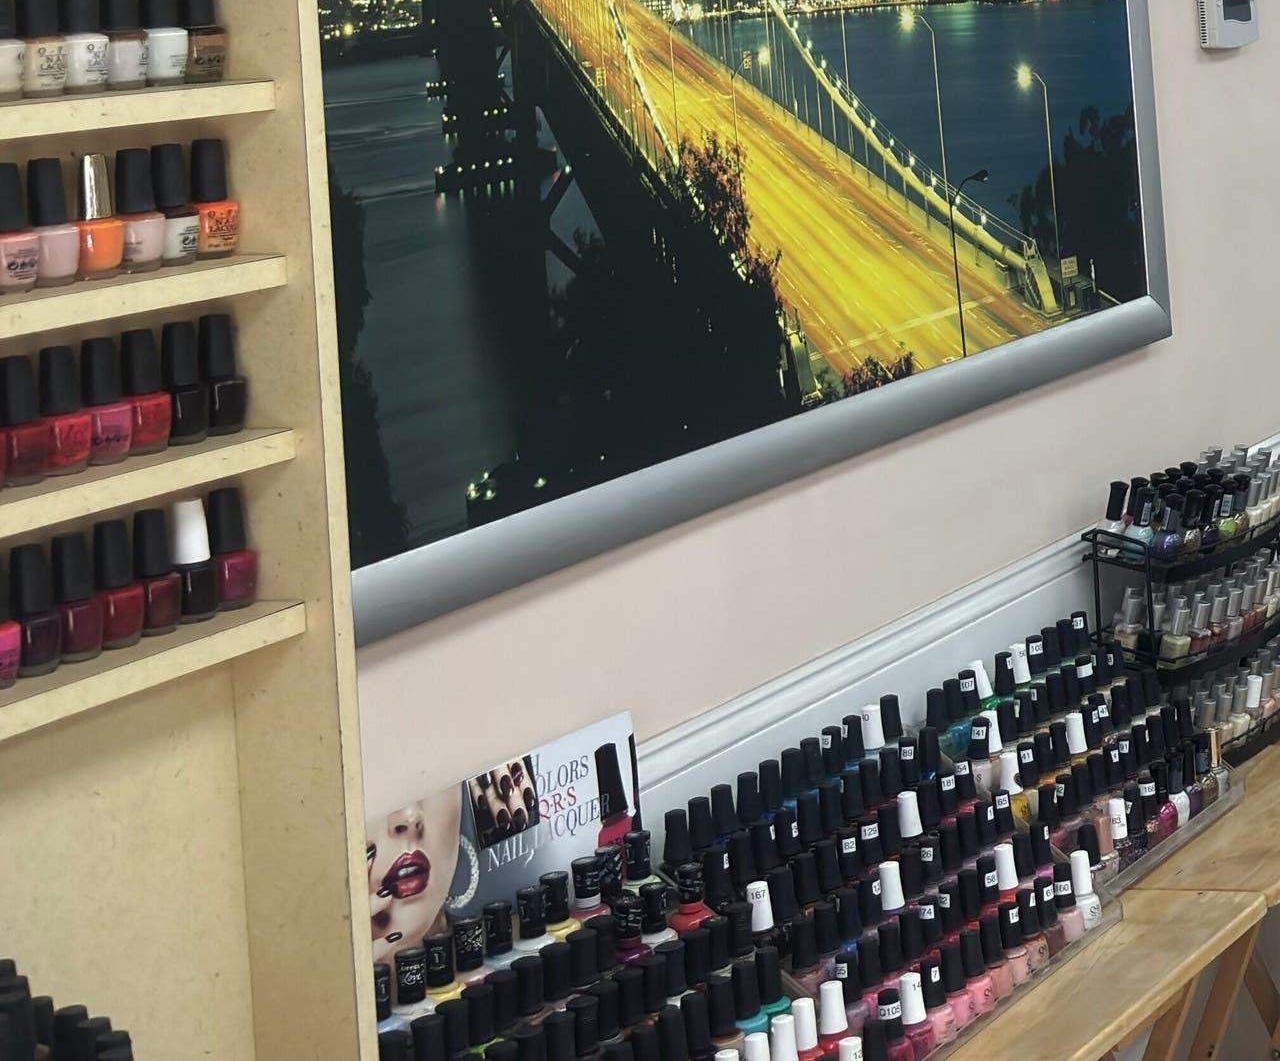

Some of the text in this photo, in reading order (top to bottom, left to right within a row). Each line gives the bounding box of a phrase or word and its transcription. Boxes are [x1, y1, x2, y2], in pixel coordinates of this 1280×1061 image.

[536, 755, 590, 798] OLORS
[997, 798, 1008, 806] 65
[844, 842, 855, 850] 82
[751, 890, 765, 900] 167
[879, 1006, 900, 1017] Q105
